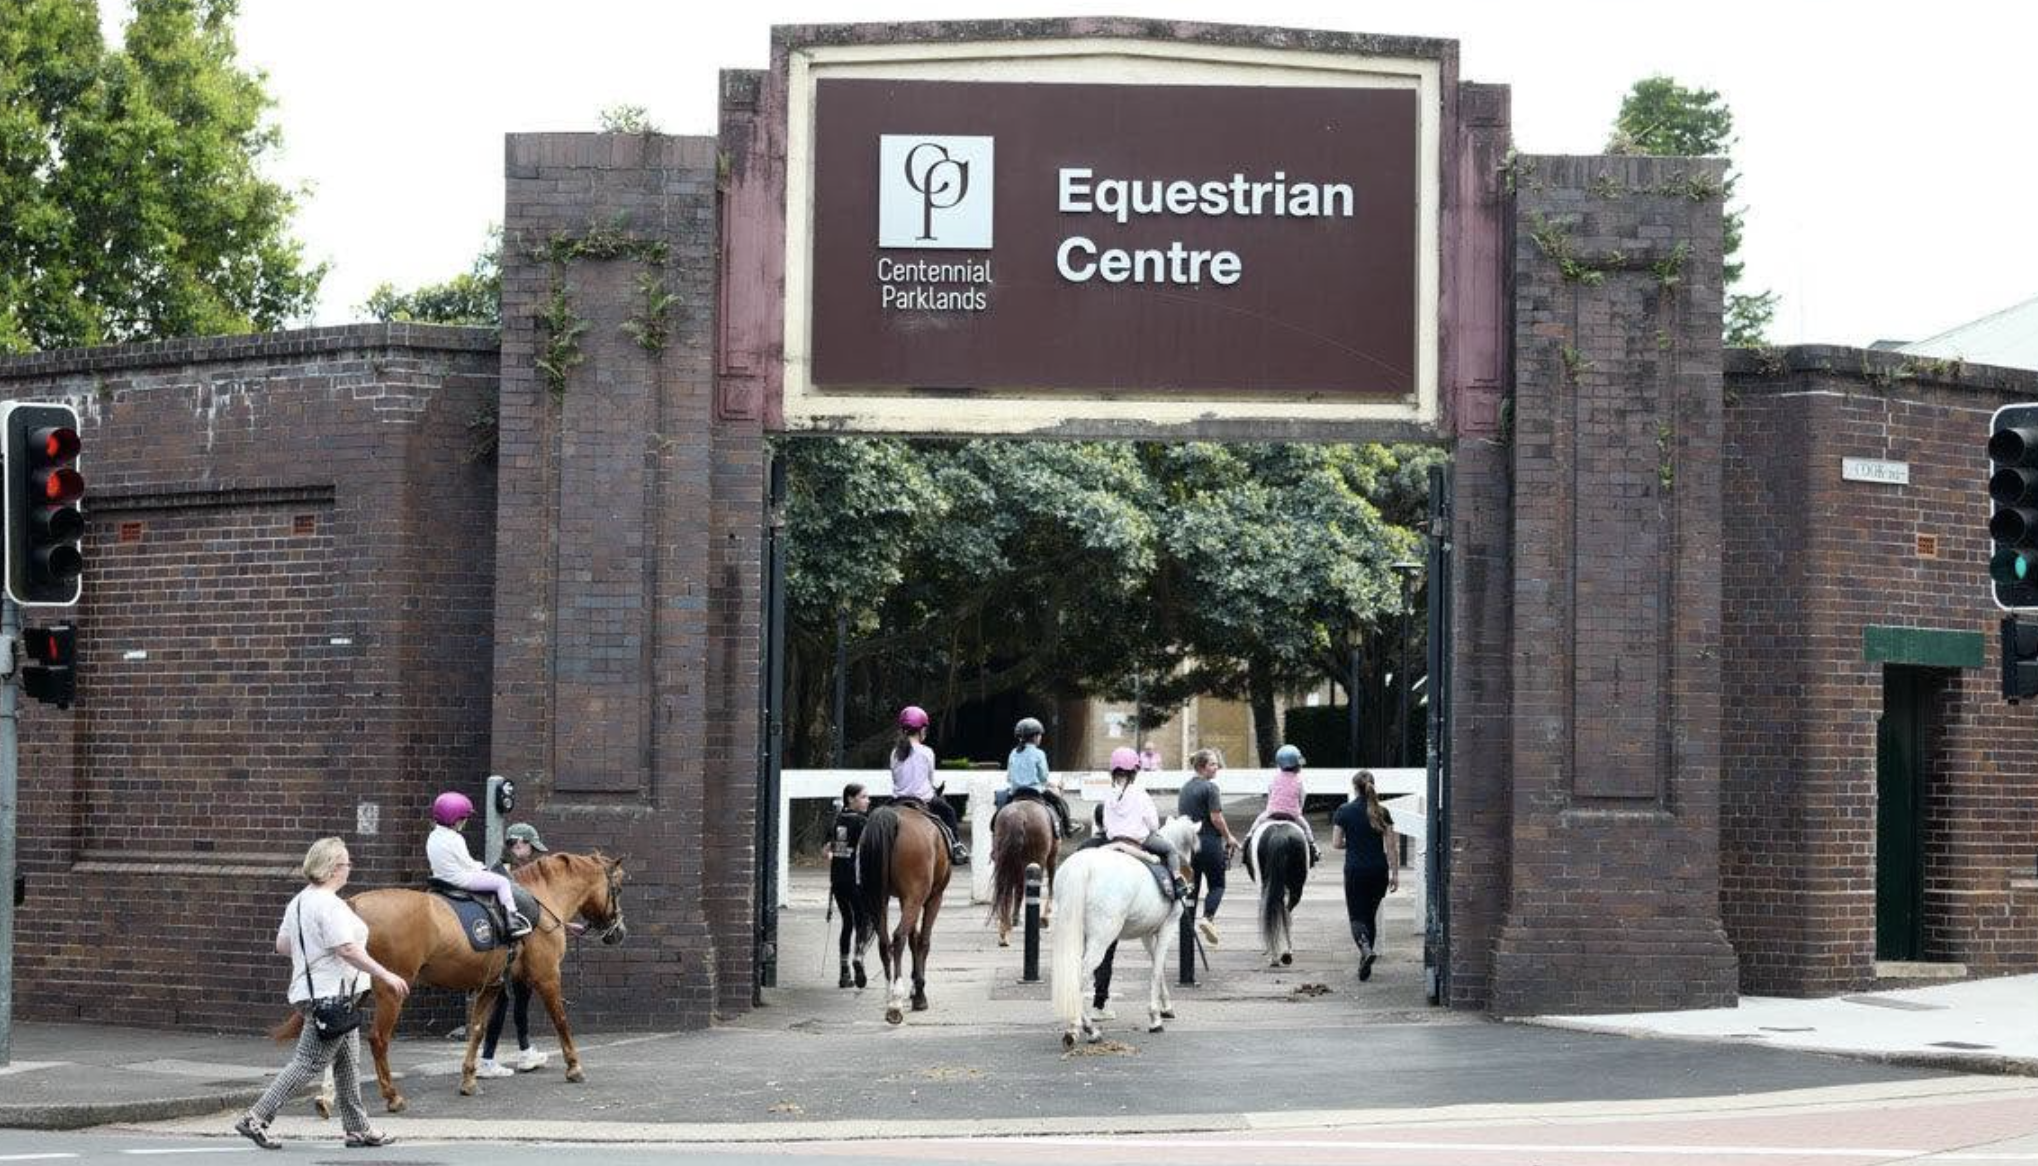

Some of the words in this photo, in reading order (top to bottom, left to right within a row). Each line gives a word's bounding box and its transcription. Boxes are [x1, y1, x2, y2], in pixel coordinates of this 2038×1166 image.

[1059, 168, 1354, 223] Equestrian
[878, 257, 993, 283] Centennial
[1056, 236, 1242, 285] Centre
[882, 285, 987, 310] Parklands
